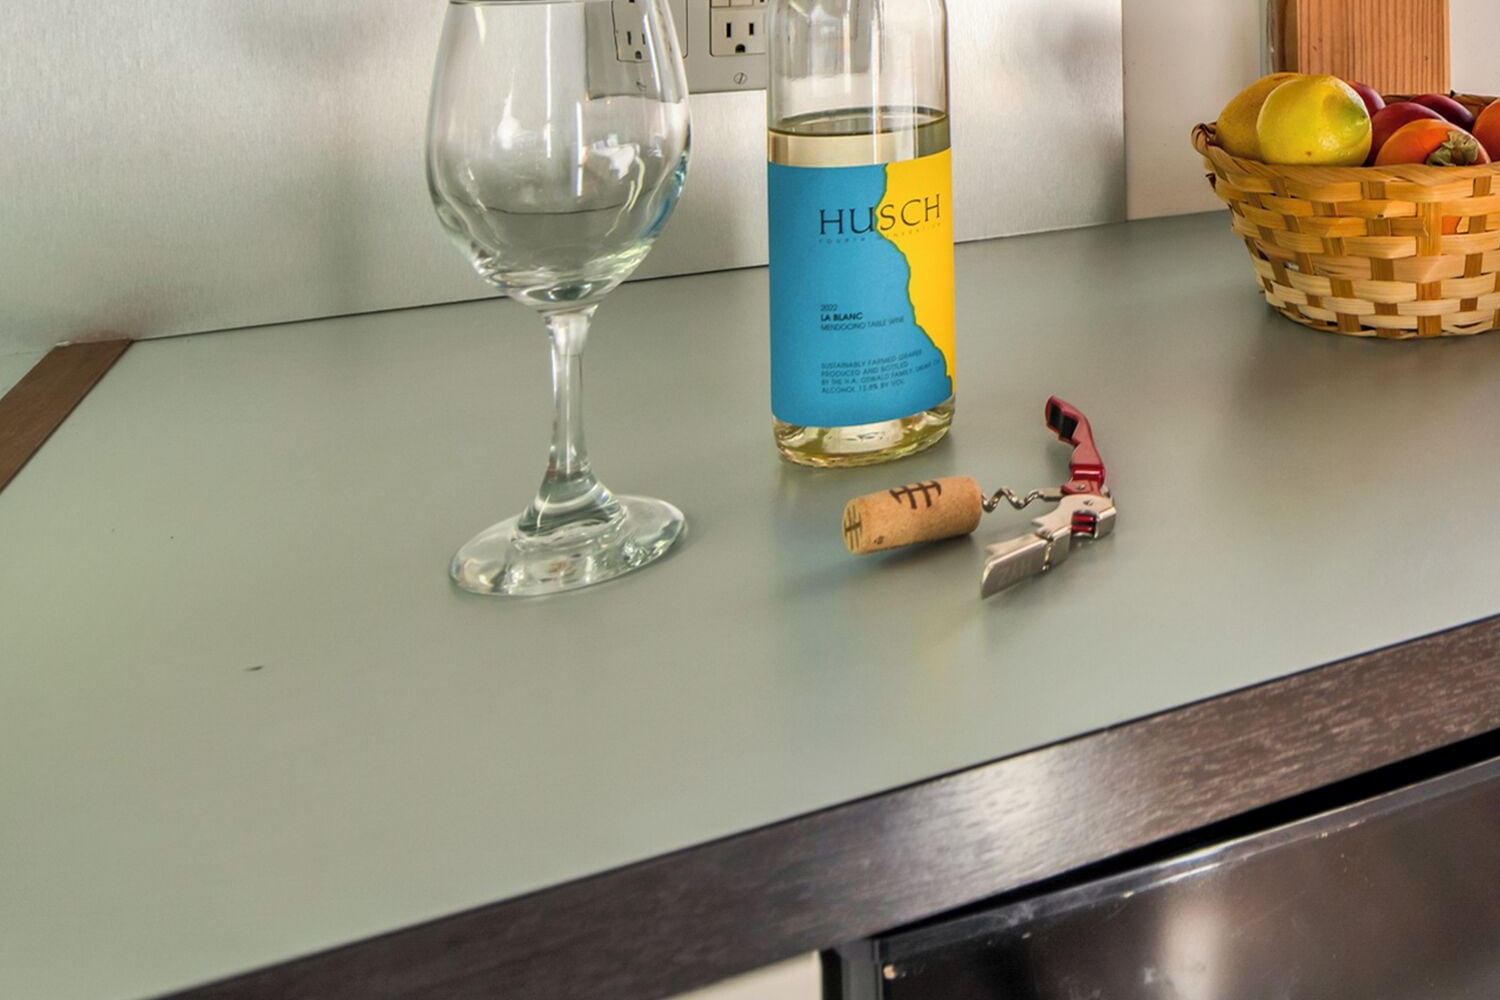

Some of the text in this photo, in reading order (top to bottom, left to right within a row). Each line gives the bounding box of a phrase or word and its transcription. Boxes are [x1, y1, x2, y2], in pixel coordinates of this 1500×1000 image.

[819, 194, 940, 235] HUSCH
[820, 312, 864, 322] LA BLANC
[820, 322, 866, 331] MENDOCINO
